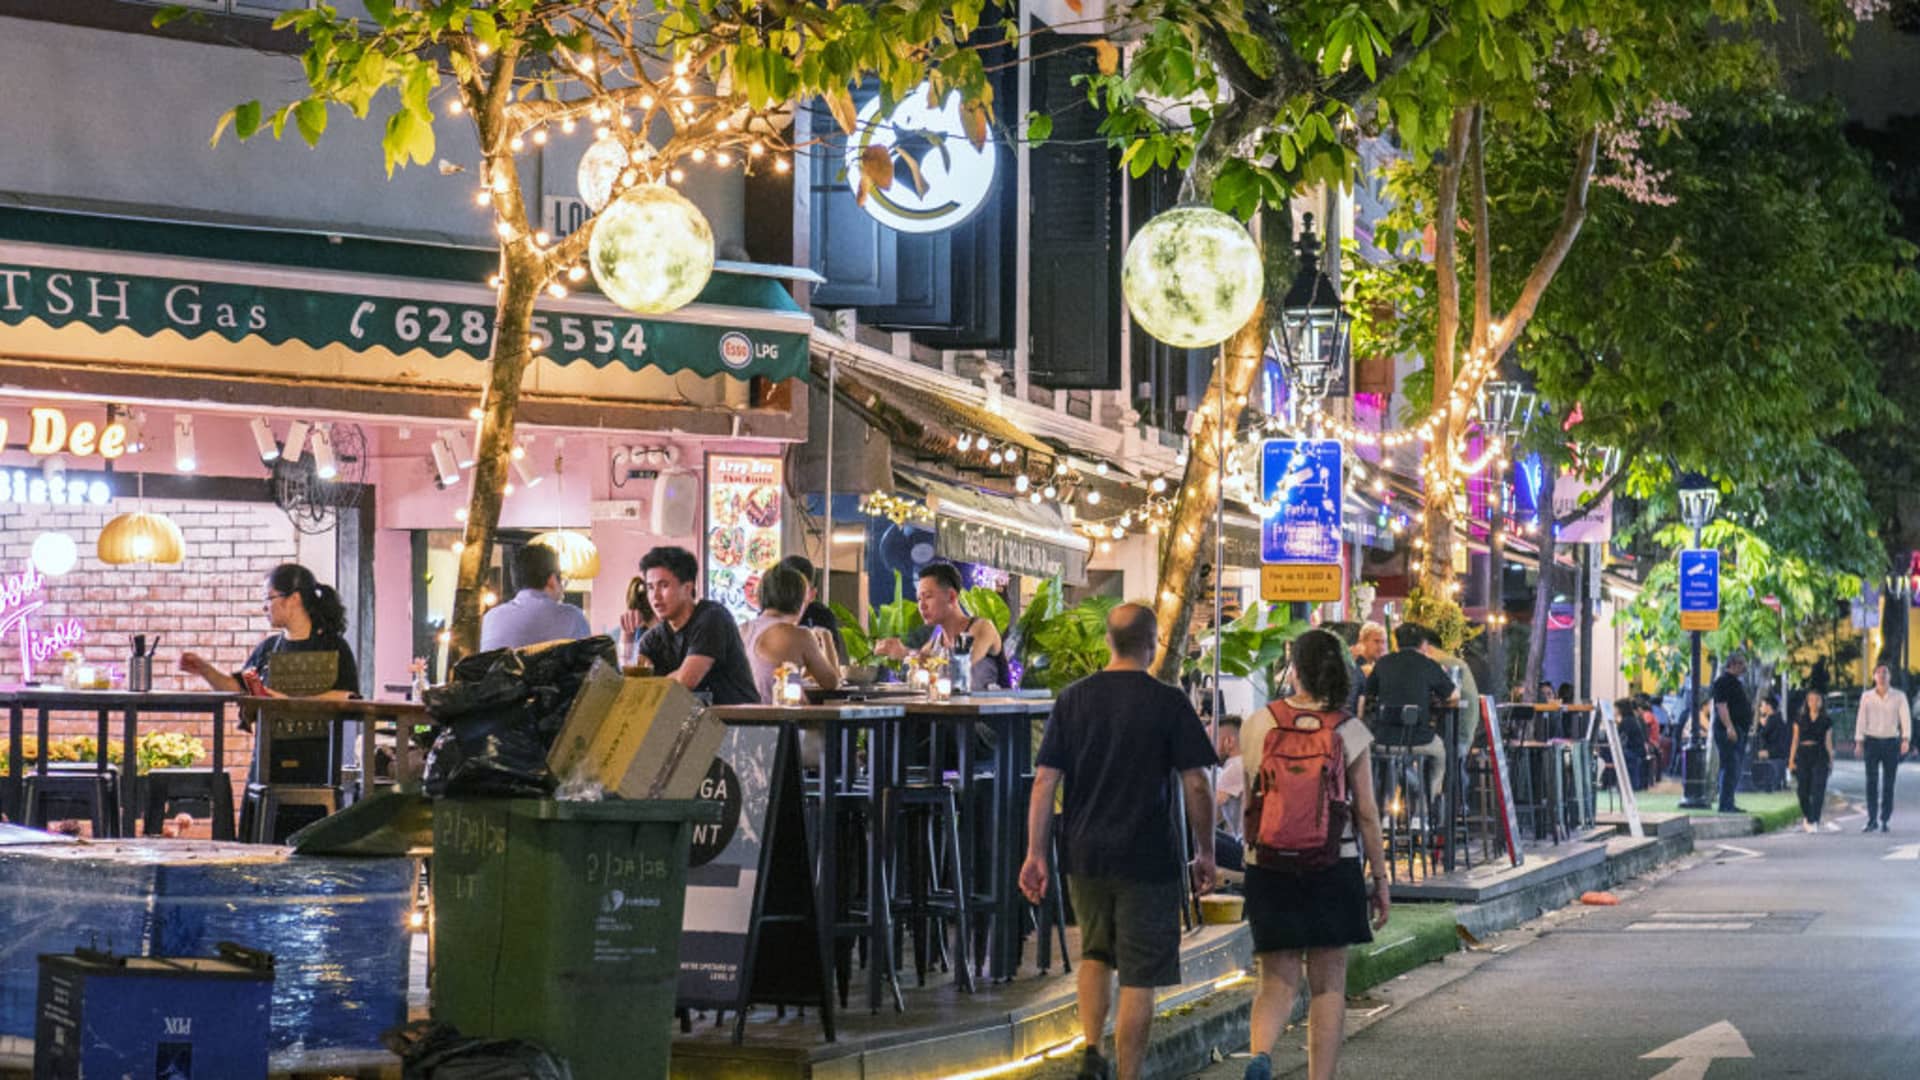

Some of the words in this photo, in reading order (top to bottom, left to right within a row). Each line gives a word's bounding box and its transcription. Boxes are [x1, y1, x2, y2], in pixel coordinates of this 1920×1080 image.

[0, 270, 131, 320] TSH
[164, 284, 267, 330] Gas
[754, 343, 779, 360] LPG
[28, 407, 127, 459] Dee
